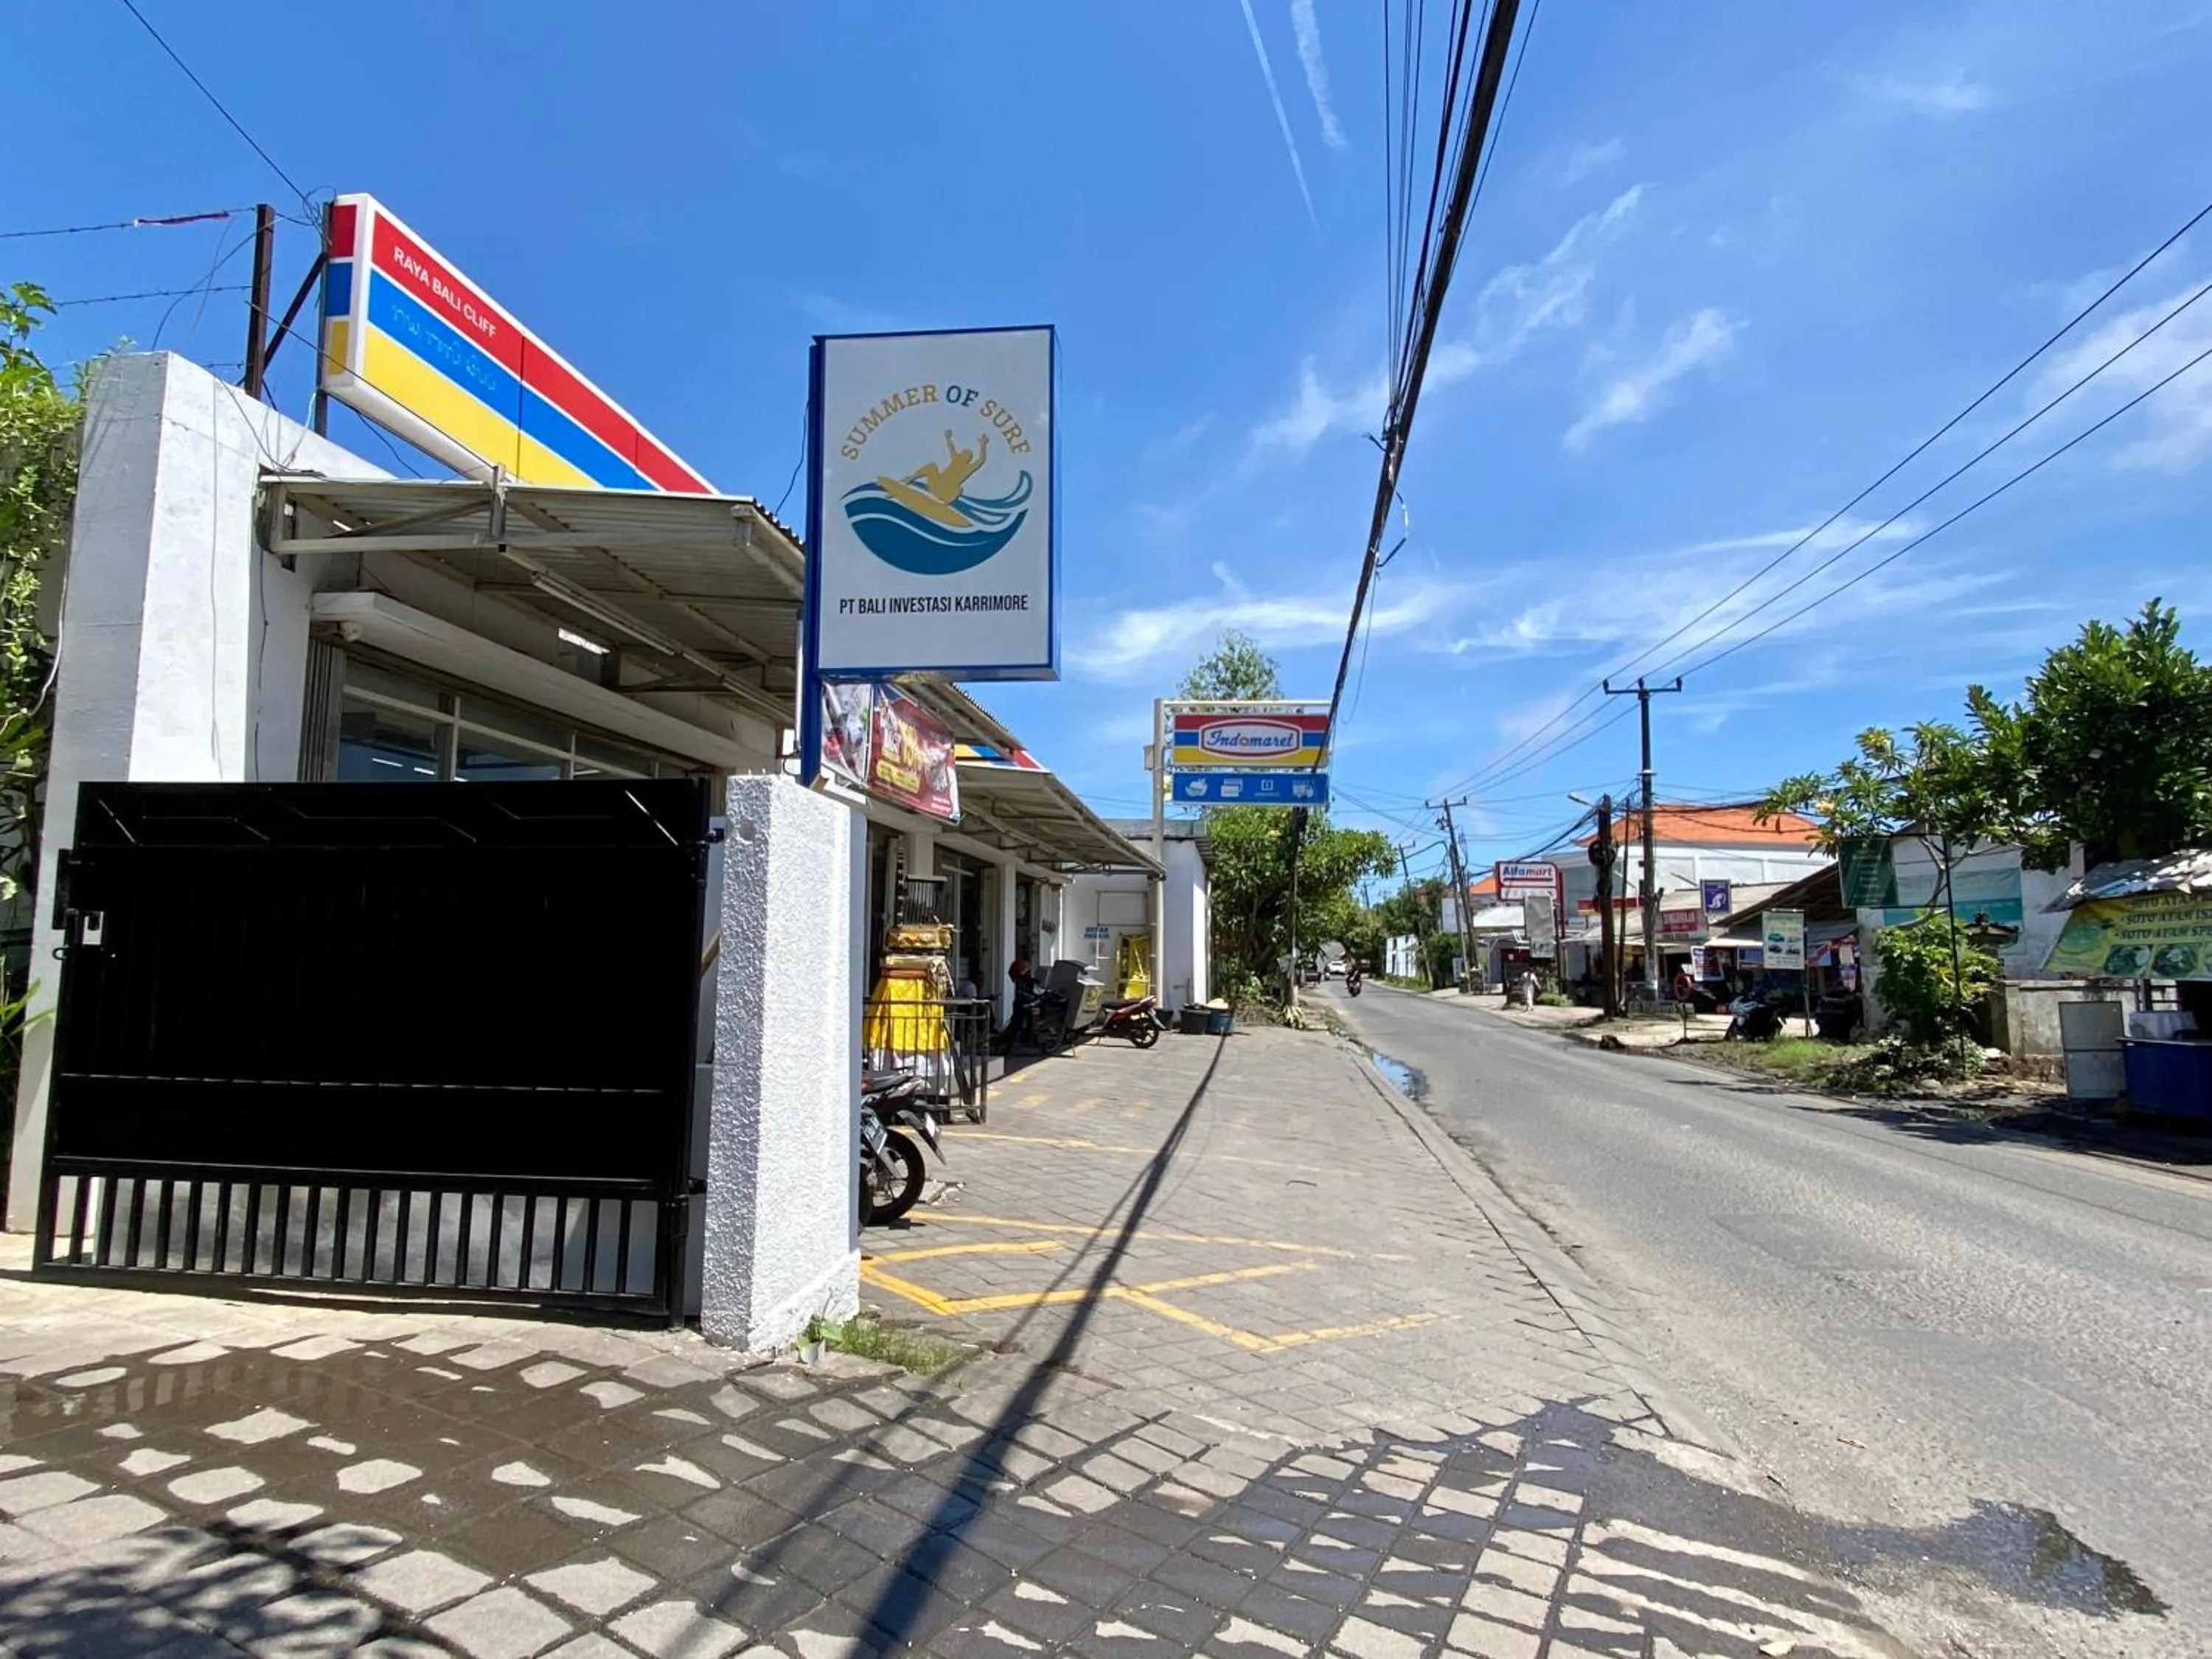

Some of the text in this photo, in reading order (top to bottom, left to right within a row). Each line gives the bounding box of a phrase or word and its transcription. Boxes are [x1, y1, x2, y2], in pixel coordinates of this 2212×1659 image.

[394, 246, 496, 338] RAYA BALI CLIFF
[841, 385, 1031, 460] SUMMER OF SURF
[839, 594, 1029, 614] PT BALI INVESTASI KARRIMORE
[1207, 730, 1293, 748] Indomaret
[1503, 866, 1552, 877] Alfamart
